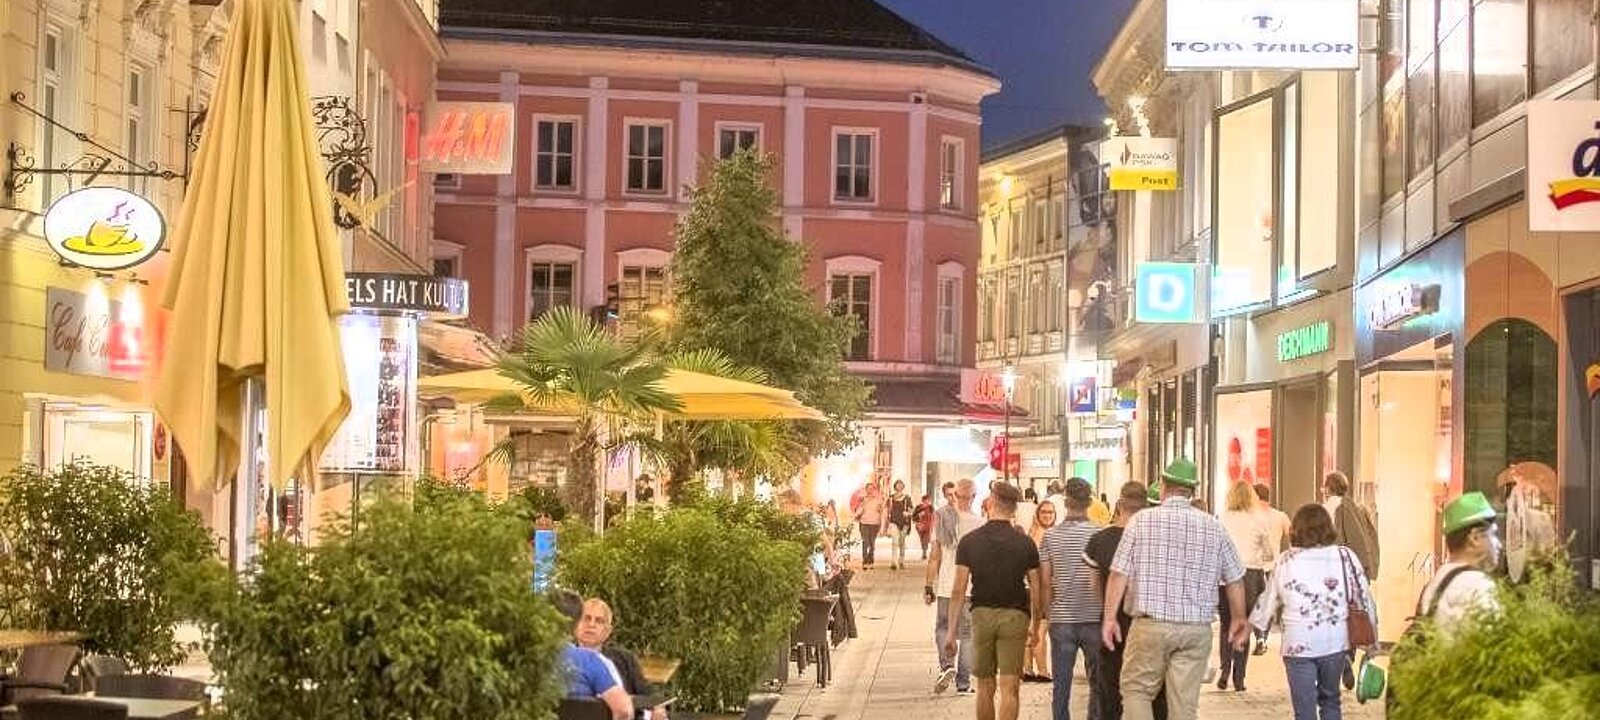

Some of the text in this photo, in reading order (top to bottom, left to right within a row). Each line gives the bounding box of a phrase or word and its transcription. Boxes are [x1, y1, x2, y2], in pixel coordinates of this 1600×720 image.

[1171, 42, 1354, 54] TOM TAILOR
[1142, 176, 1168, 185] Post
[383, 279, 417, 304] HAT
[1148, 273, 1185, 311] D
